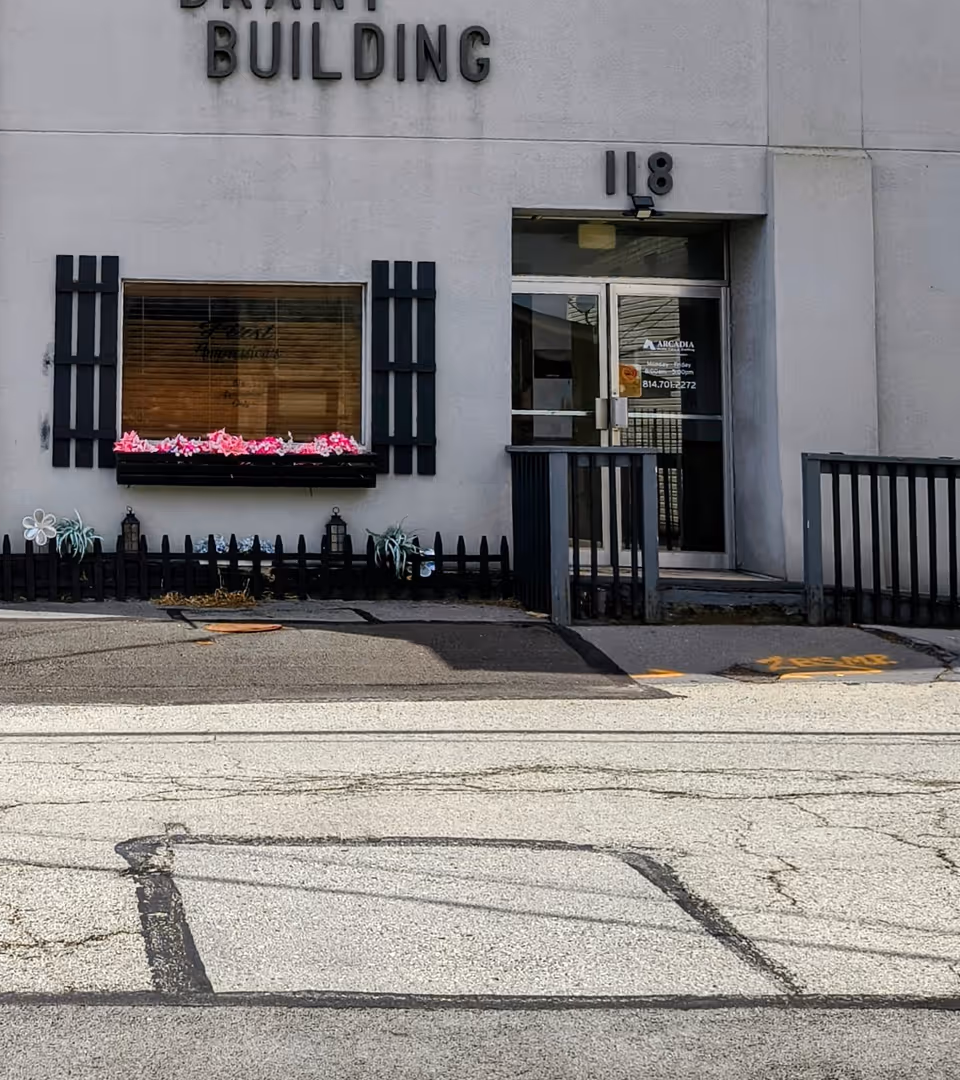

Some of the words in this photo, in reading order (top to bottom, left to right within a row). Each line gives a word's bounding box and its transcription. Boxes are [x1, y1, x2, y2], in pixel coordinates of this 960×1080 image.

[207, 20, 490, 82] BUILDING
[606, 150, 673, 196] 118
[657, 340, 695, 348] ARCADIA
[642, 380, 697, 389] 814.701.2272
